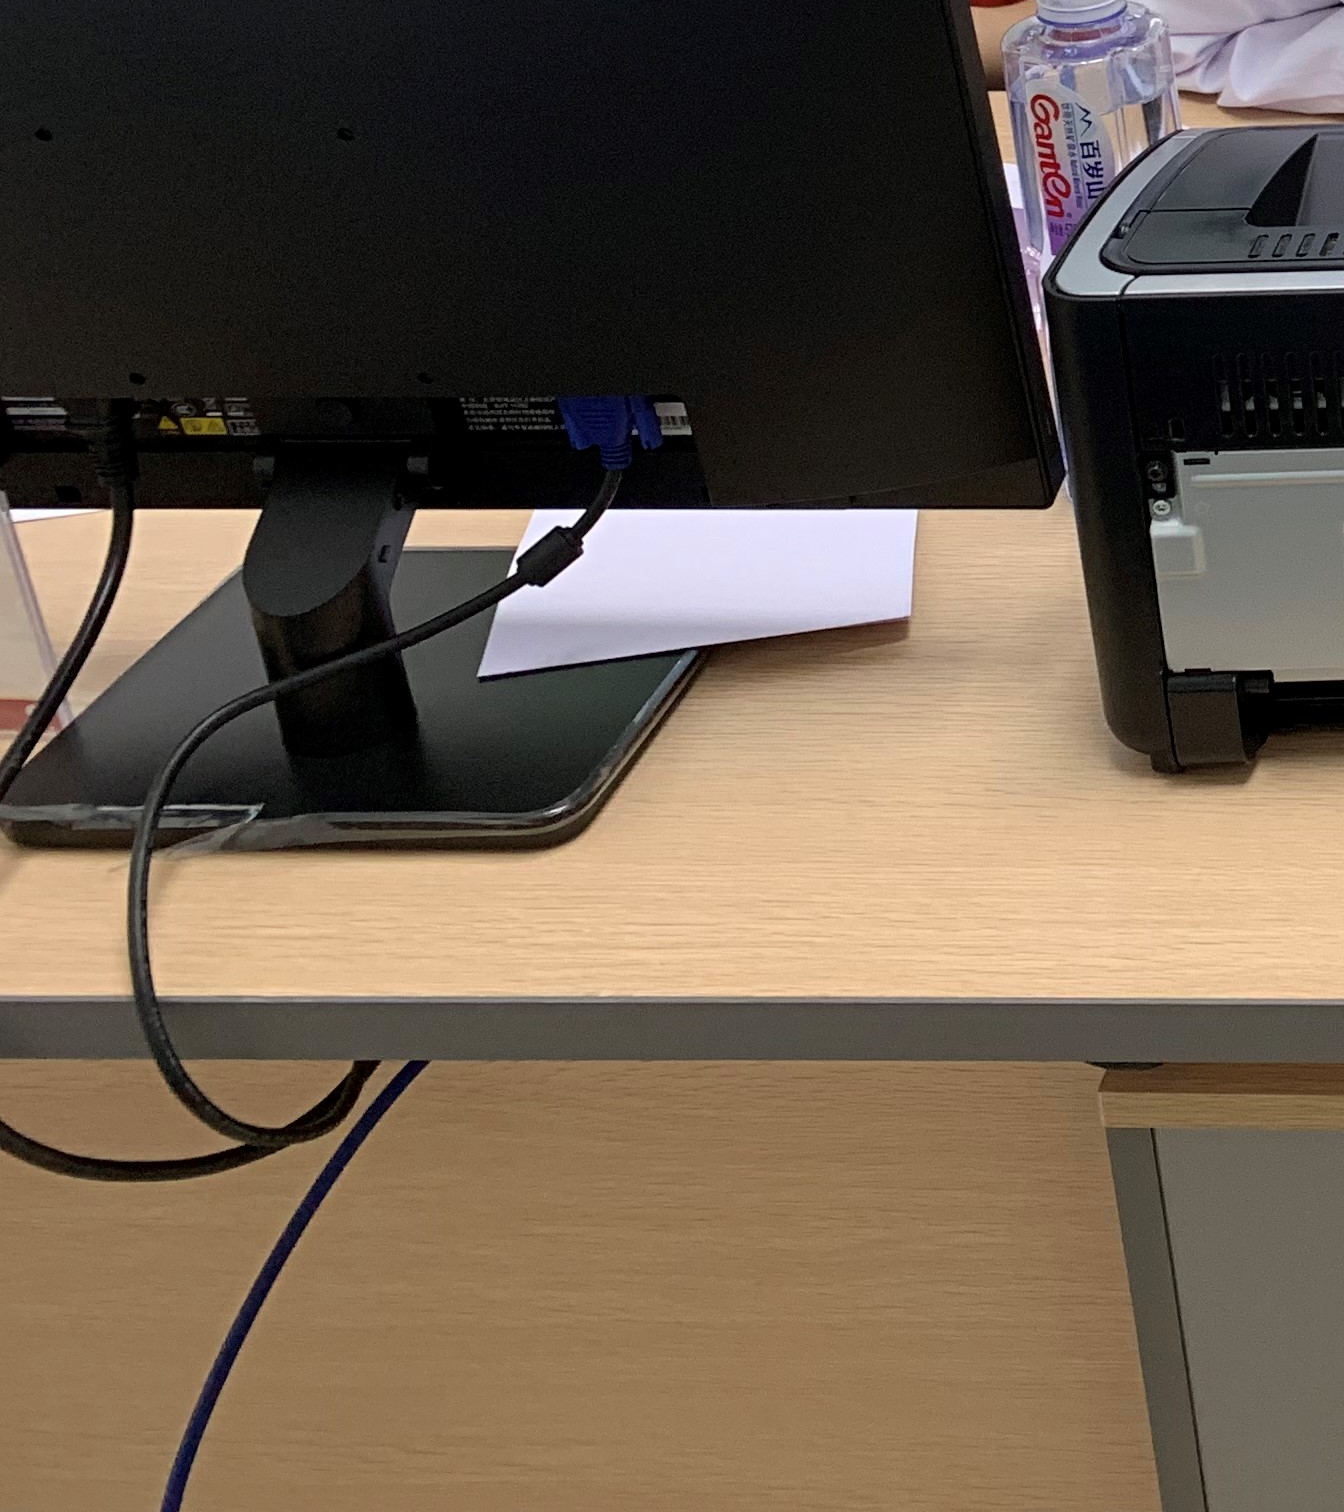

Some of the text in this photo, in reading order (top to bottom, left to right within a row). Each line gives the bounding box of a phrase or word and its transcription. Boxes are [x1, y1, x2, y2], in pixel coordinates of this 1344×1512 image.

[1030, 94, 1071, 218] Ganten
[1080, 140, 1104, 199] 百岁山
